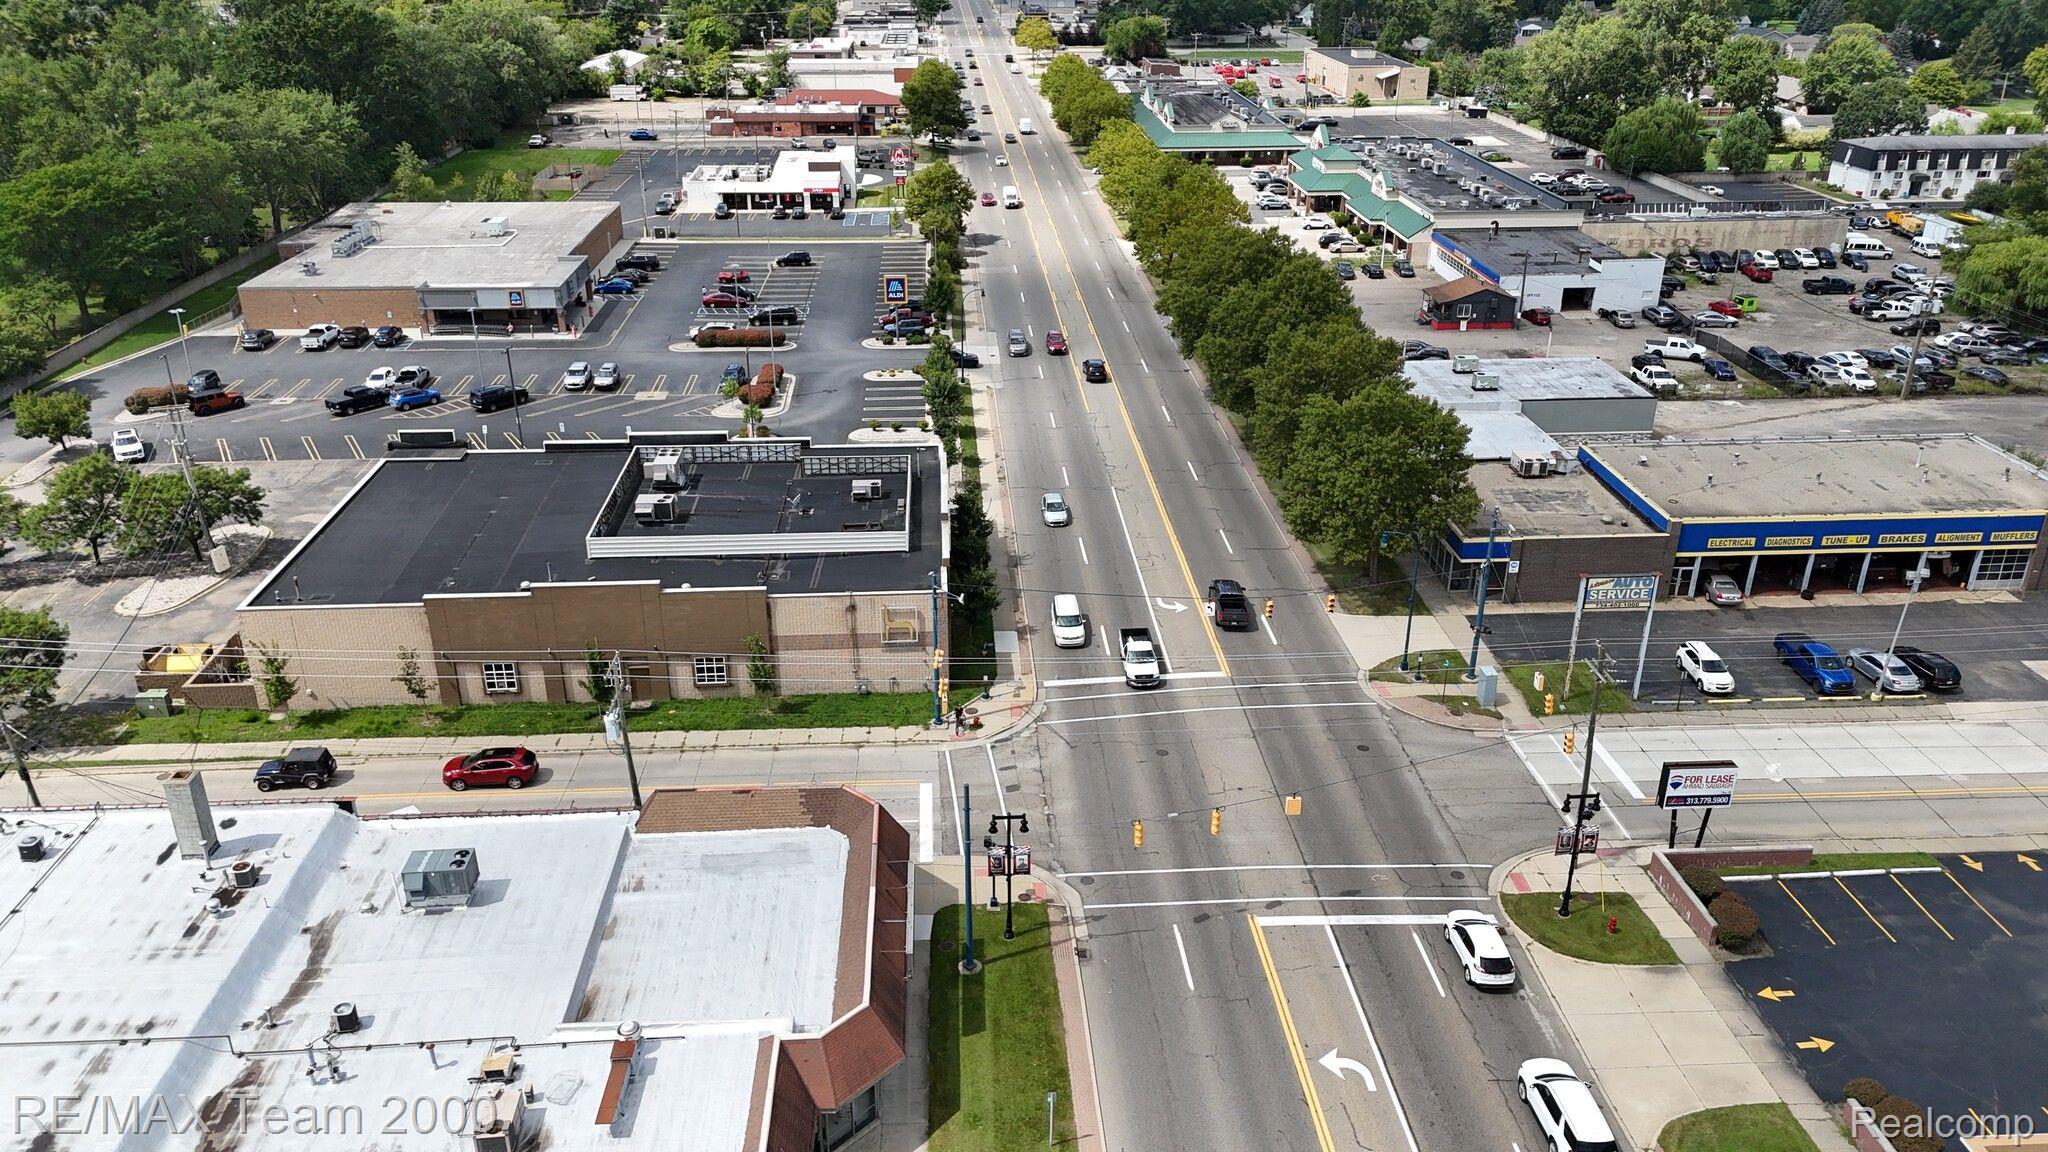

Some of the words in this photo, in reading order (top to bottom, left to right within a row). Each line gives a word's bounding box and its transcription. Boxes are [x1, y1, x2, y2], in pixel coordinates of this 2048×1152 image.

[1880, 535, 1925, 543] BRAKES
[1936, 533, 1981, 542] ALIGNMENT
[1992, 531, 2036, 540] MUFFLERS
[1766, 538, 1812, 546] DIAGNOSTICS
[1613, 577, 1655, 588] AUTO
[1589, 588, 1650, 600] SERVICE
[1684, 775, 1703, 784] FOR
[1705, 774, 1735, 783] LEASE
[1685, 796, 1729, 805] 313.779.5900
